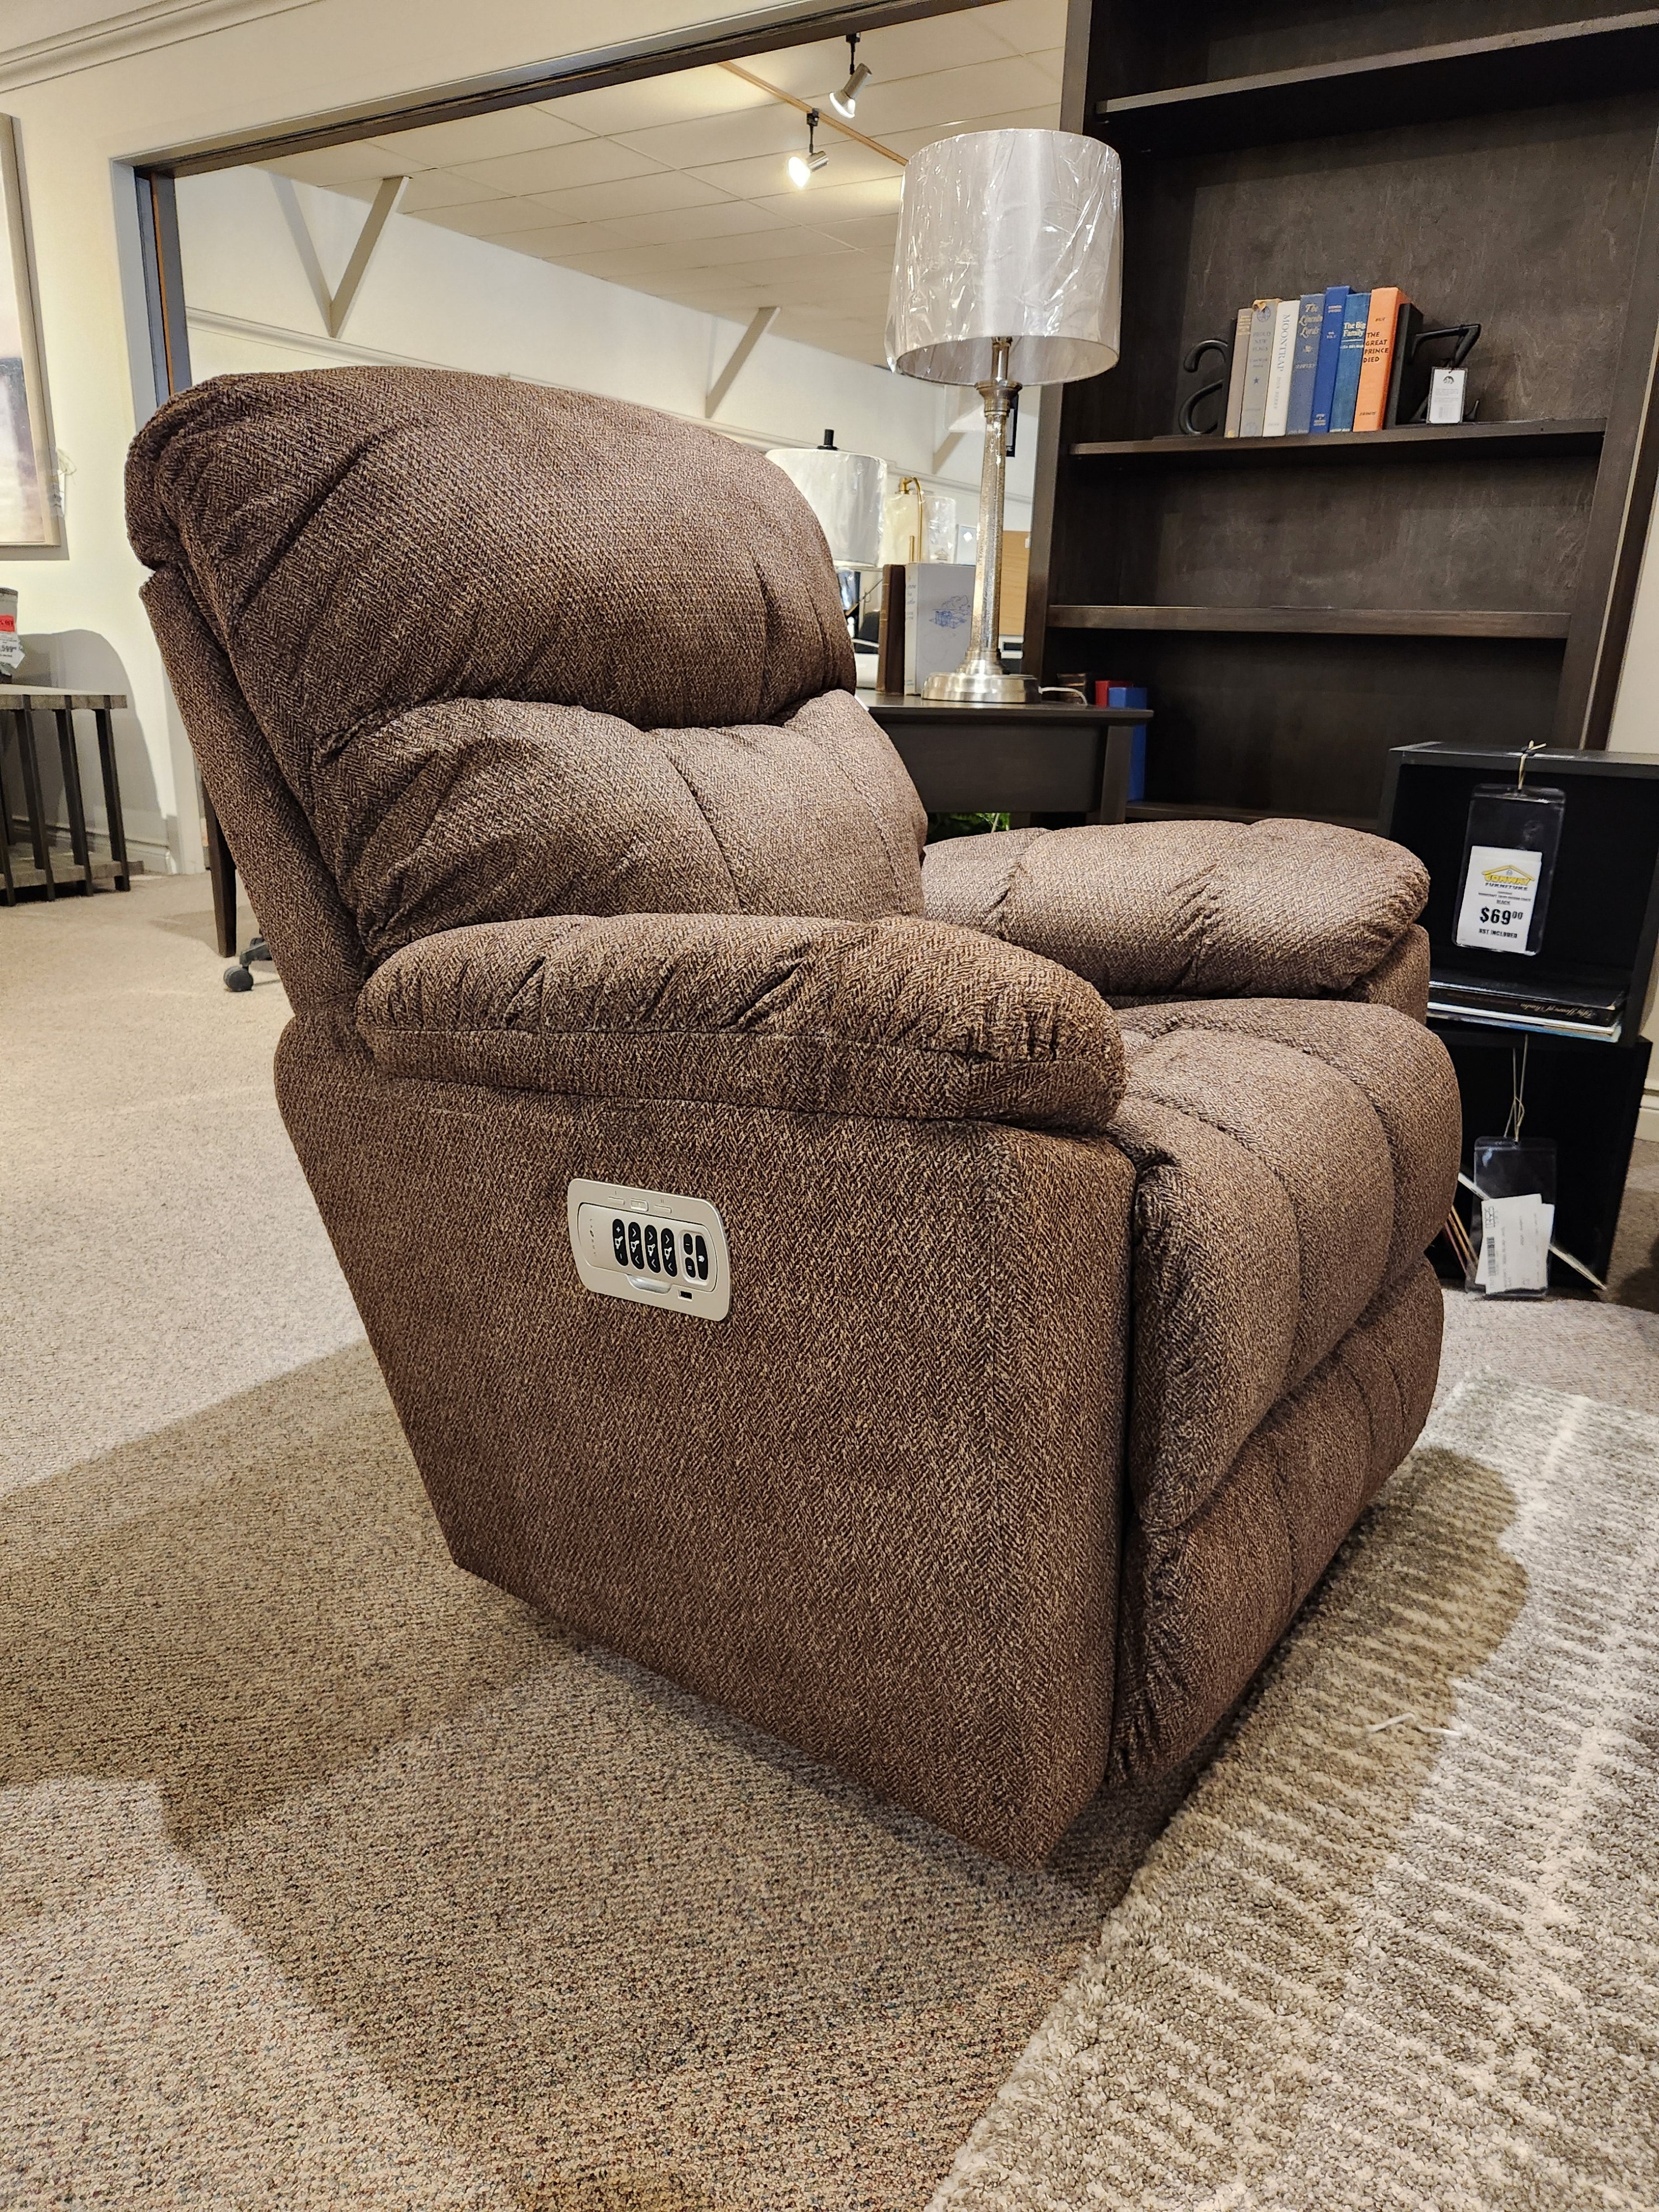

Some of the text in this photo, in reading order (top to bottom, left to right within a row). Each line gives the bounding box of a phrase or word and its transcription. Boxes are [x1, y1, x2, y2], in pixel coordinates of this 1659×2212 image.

[1355, 321, 1366, 330] Big
[1343, 329, 1365, 337] Family
[1277, 314, 1291, 372] MOONTRAP
[1484, 874, 1531, 886] CONWAY
[1485, 882, 1528, 891] FURNITURE
